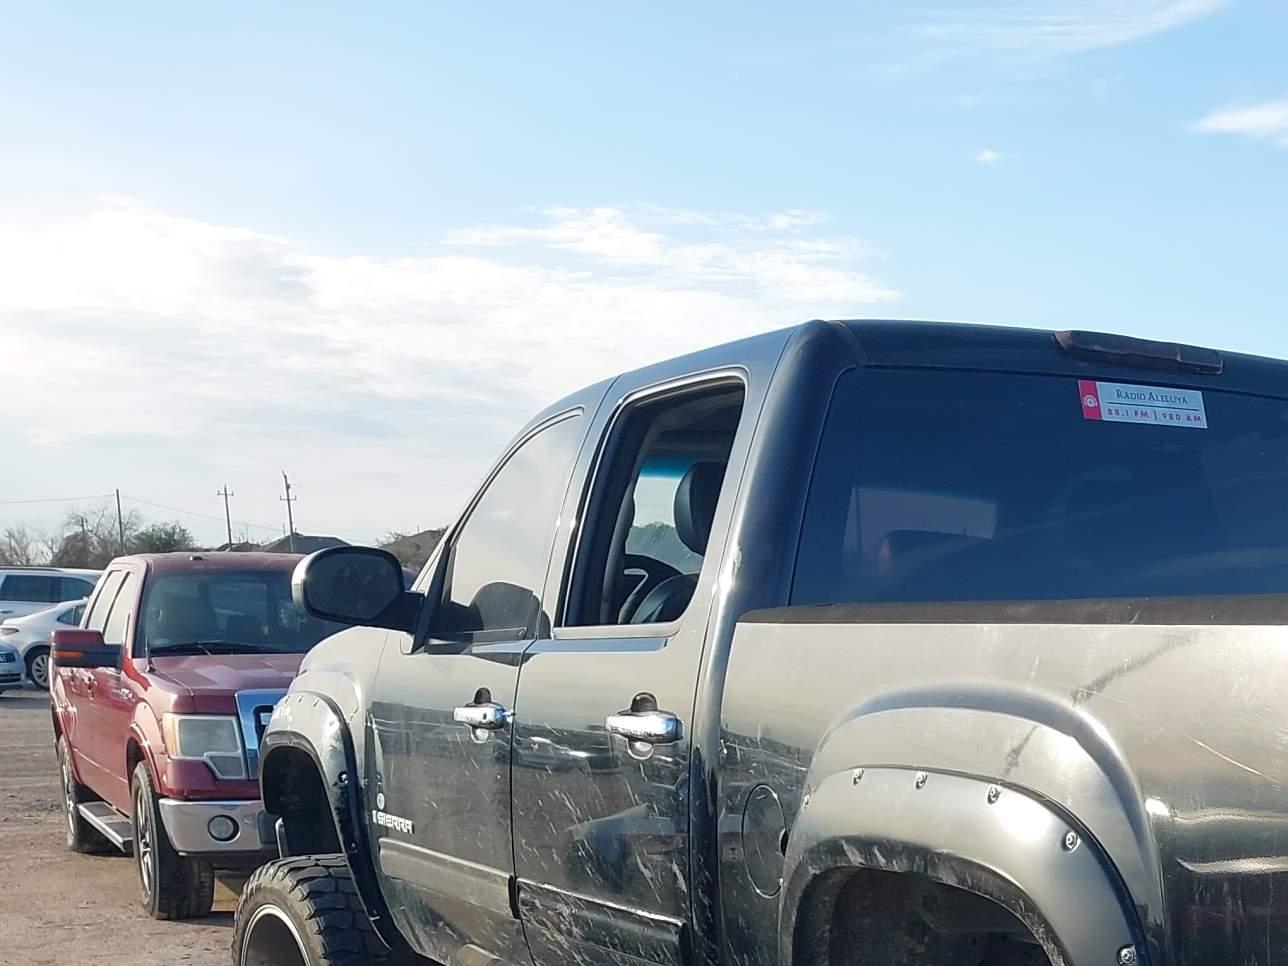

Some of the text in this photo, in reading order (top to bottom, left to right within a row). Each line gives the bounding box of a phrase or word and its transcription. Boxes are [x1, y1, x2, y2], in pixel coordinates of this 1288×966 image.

[1116, 389, 1146, 401] RADIO
[1134, 408, 1150, 418] FM
[1186, 414, 1201, 423] AM
